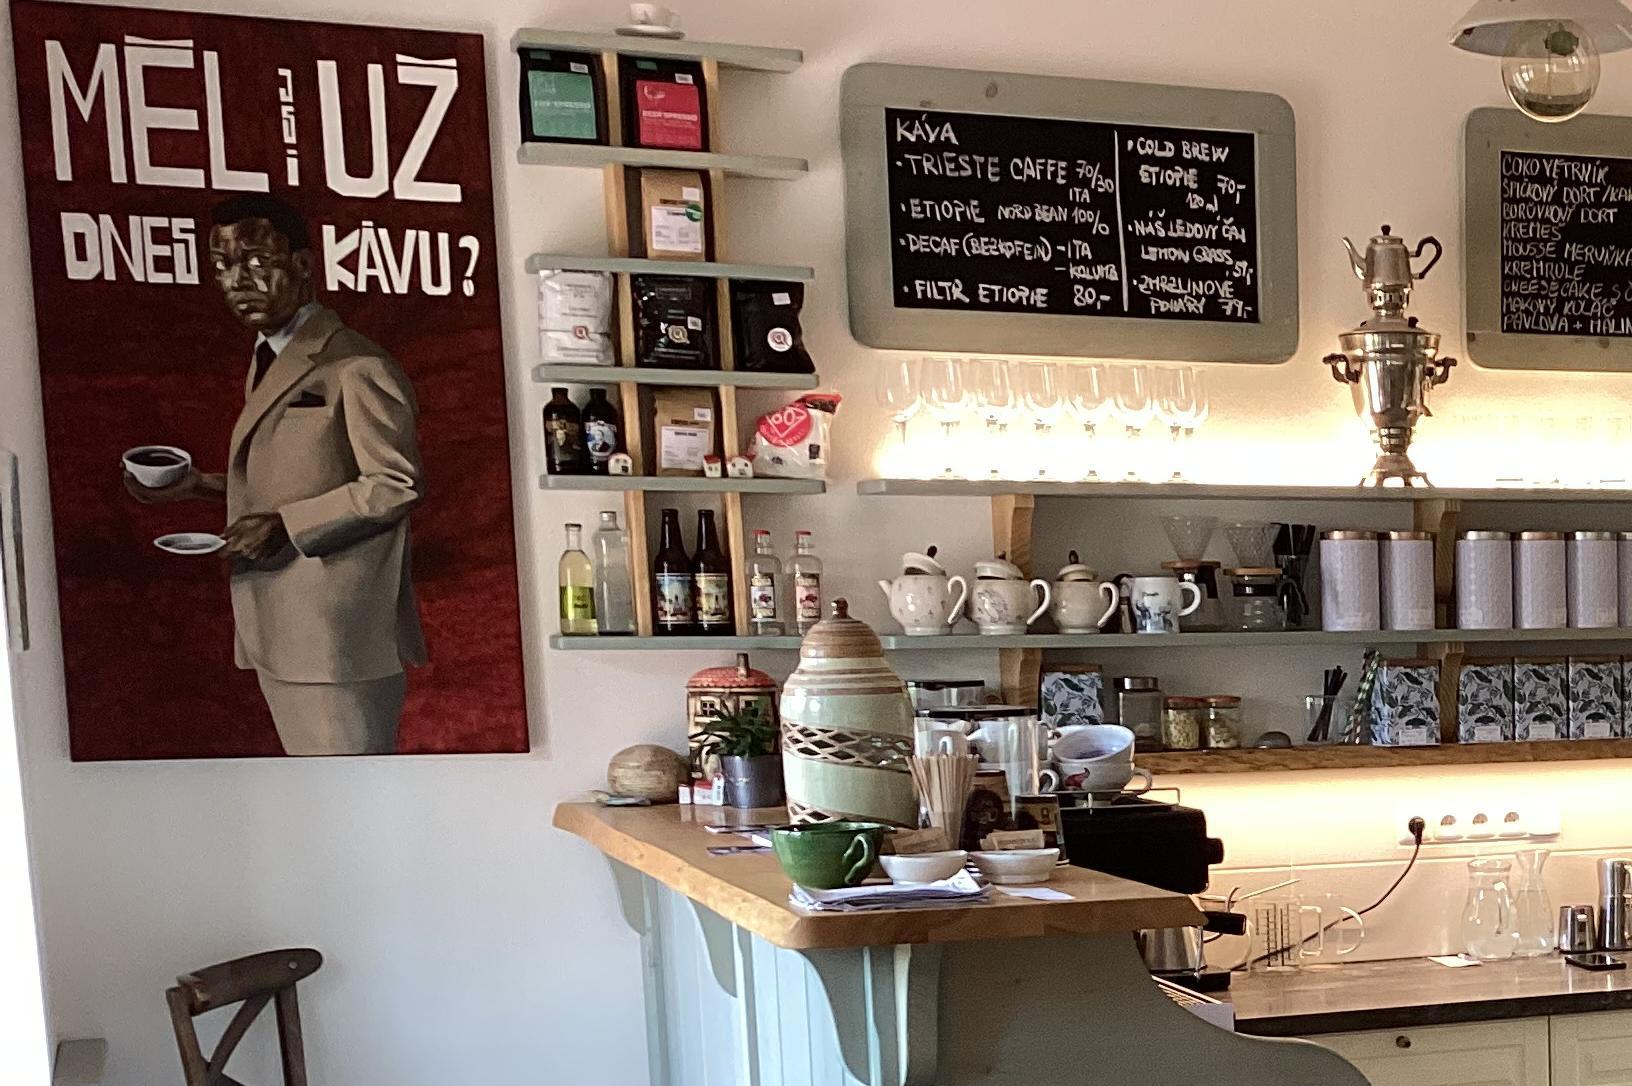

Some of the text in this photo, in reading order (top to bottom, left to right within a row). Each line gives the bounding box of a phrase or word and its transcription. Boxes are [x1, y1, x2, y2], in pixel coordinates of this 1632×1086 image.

[44, 34, 270, 193] MĚL
[316, 53, 463, 203] UŽ
[896, 113, 959, 146] KÁVA
[1137, 137, 1230, 163] COLD BREW
[904, 151, 1116, 194] TRIESTE CAFFE 70/30
[1139, 164, 1247, 205] ETIOPIE 70,-
[1069, 187, 1091, 203] ITA
[1205, 194, 1219, 213] ml
[1563, 184, 1601, 204] DORT
[909, 197, 985, 223] ETIOPIE
[1072, 206, 1110, 235] 100/0
[1581, 207, 1619, 224] DORT
[59, 211, 481, 298] DNES KÁVU?
[906, 233, 960, 257] DECAF
[1503, 240, 1557, 259] MOUSSE
[915, 278, 1111, 310] FILTR ETIOPIE 80,-
[1503, 313, 1569, 332] PAVLOVA
